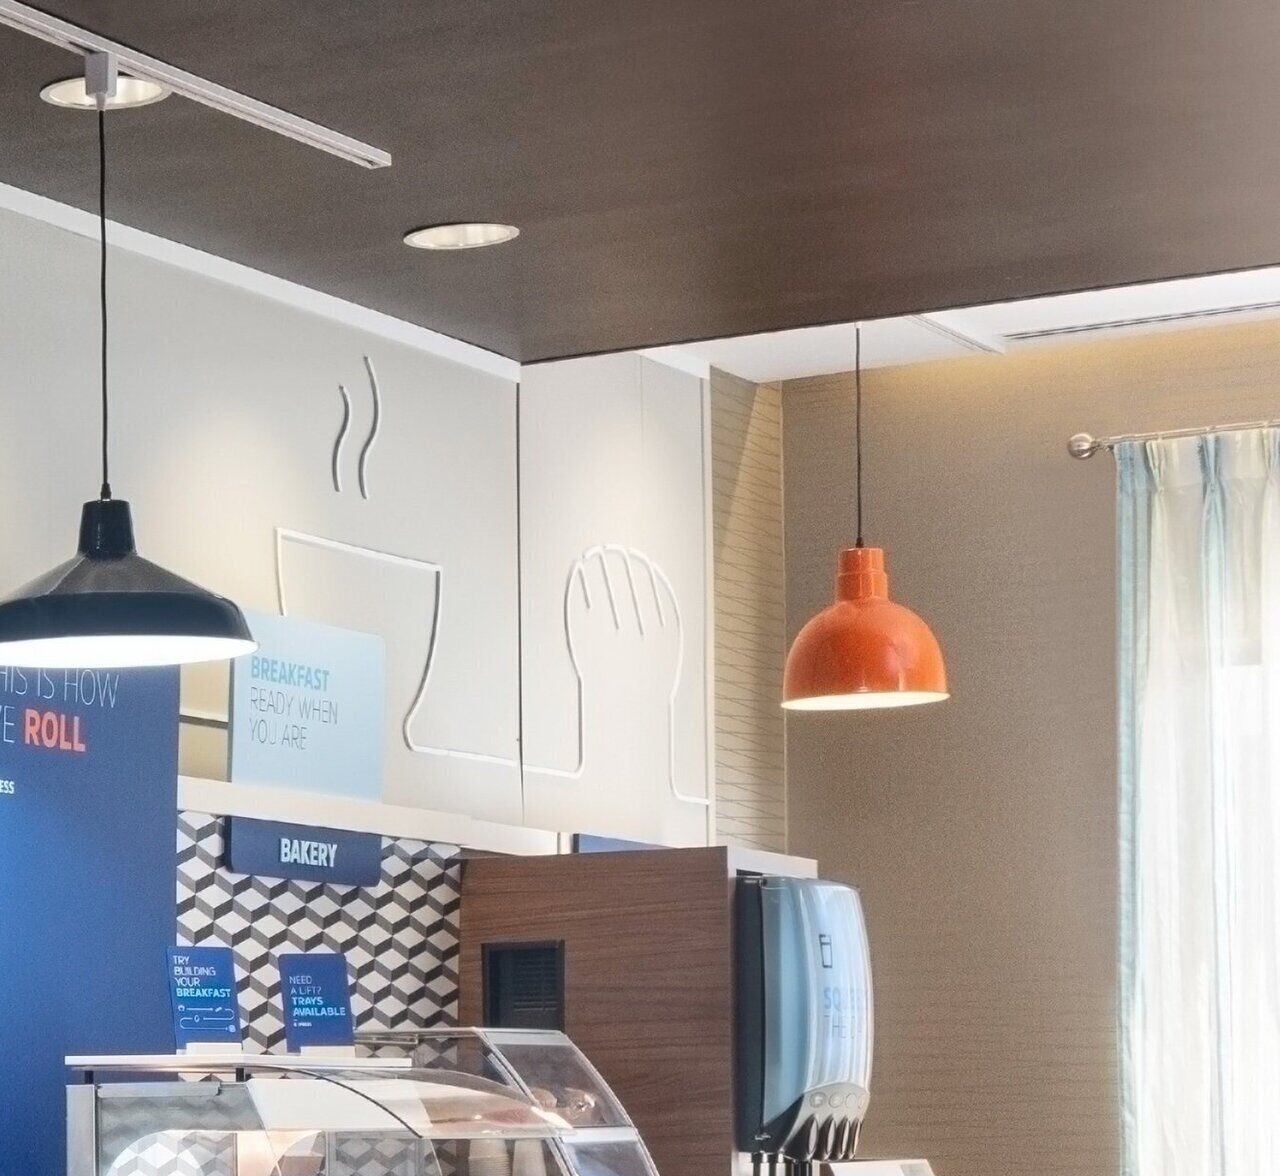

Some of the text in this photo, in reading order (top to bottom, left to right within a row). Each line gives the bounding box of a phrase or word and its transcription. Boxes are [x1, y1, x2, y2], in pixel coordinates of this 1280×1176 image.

[250, 656, 330, 692] BREAKFAST
[37, 668, 55, 700] IS
[63, 668, 120, 709] HOW
[250, 686, 339, 726] READY WHEN
[24, 708, 87, 753] ROLL
[249, 717, 308, 751] YOU ARE
[279, 837, 338, 868] BAKERY
[172, 955, 190, 965] TRY
[173, 966, 216, 976] BUILDING
[174, 977, 200, 987] YOUR
[288, 975, 313, 985] NEED
[176, 988, 232, 998] BREAKFAST
[292, 996, 324, 1005] TRAYS
[292, 1006, 347, 1017] AVAILABLE
